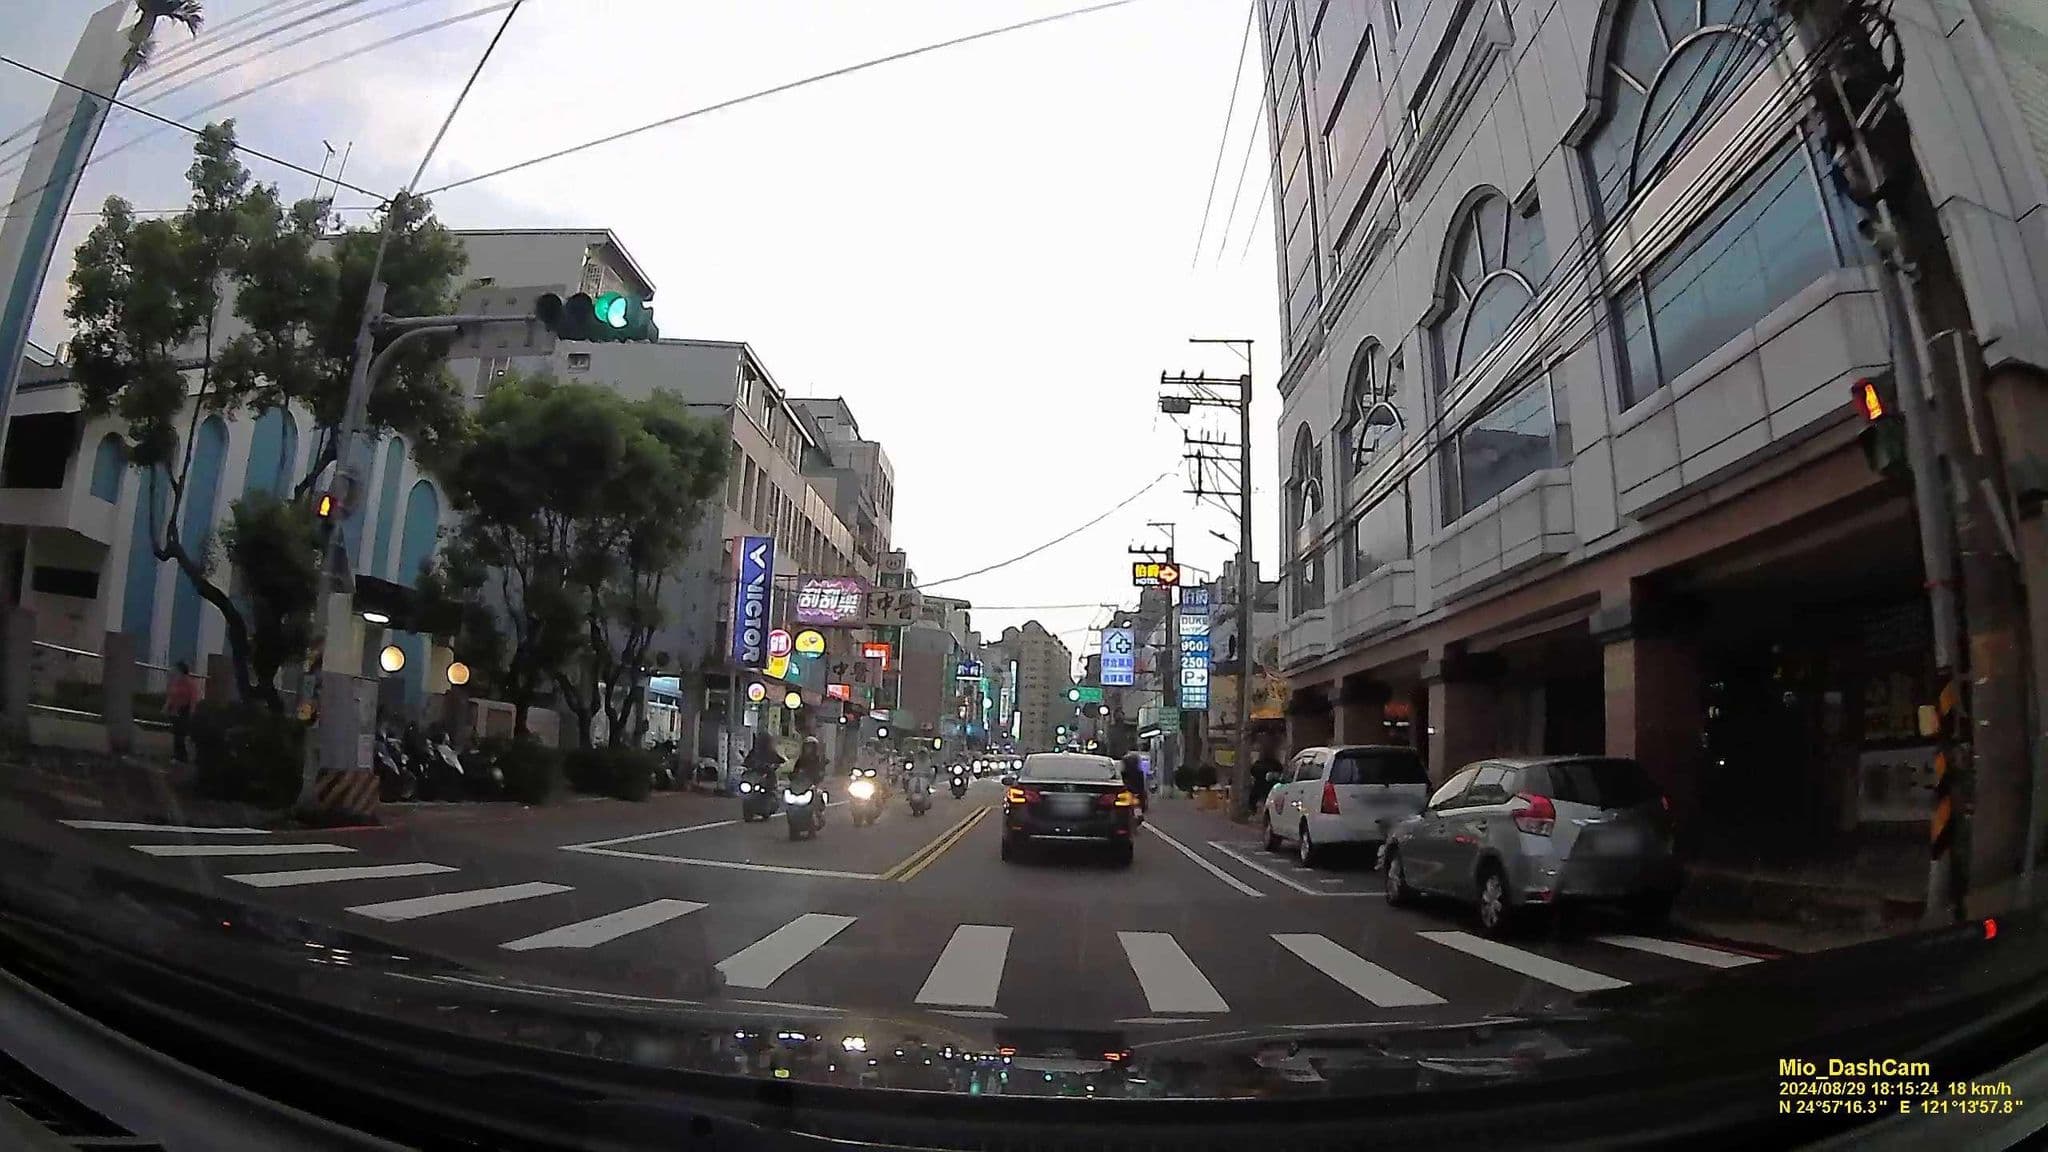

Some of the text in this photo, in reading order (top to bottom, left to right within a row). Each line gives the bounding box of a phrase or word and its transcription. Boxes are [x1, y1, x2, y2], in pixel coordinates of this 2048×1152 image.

[742, 573, 765, 663] VICTOR
[1182, 616, 1207, 625] DUKE
[1184, 671, 1195, 684] P
